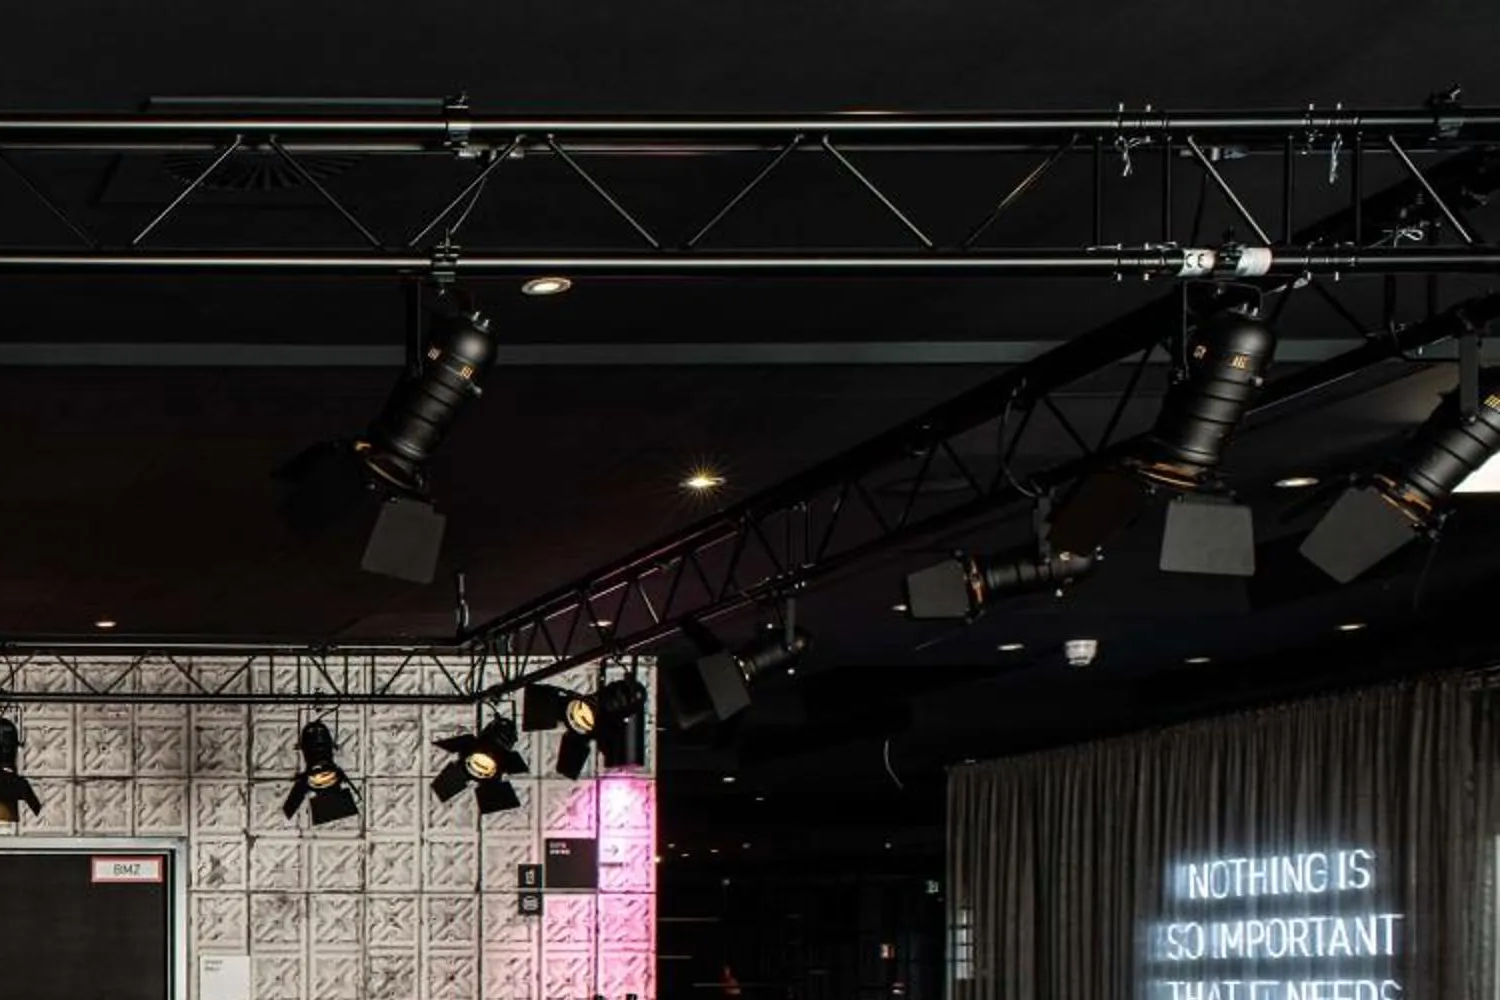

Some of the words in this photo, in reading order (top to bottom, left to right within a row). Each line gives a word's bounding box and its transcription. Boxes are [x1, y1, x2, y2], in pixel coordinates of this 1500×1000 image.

[113, 863, 141, 875] BMZ
[1188, 853, 1329, 900] NOTHING
[1338, 849, 1373, 890] IS
[1166, 921, 1204, 961] SO
[1211, 913, 1404, 960] IMPORTANT
